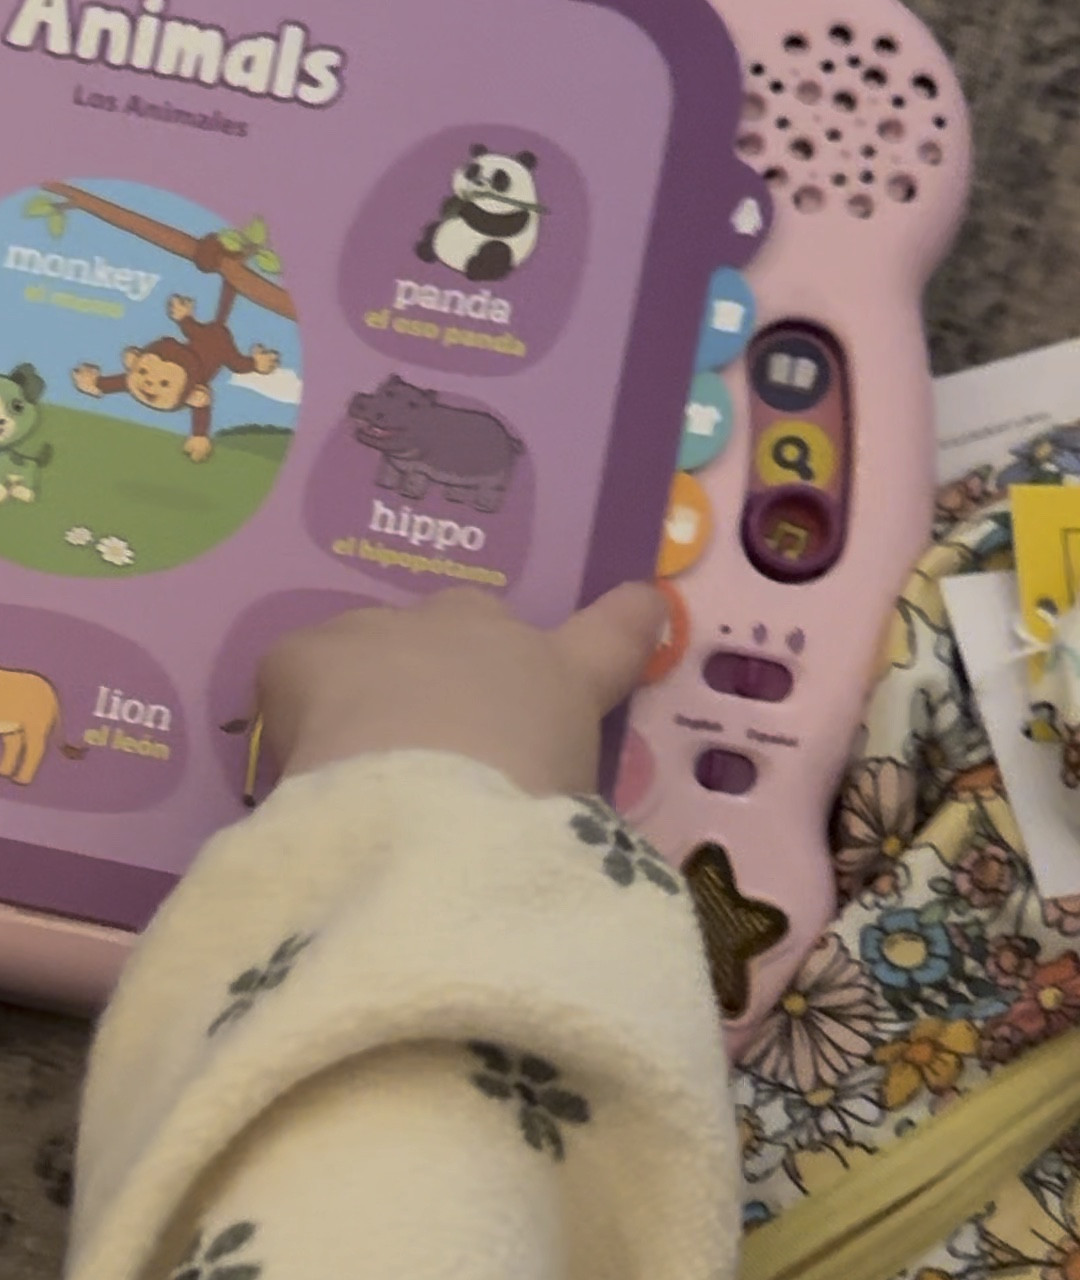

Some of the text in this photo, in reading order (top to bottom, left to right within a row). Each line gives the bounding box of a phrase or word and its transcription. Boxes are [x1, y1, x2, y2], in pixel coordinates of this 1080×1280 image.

[73, 84, 117, 112] Los
[3, 245, 160, 302] monkey
[393, 279, 512, 325] panda
[369, 499, 486, 551] hippo
[92, 685, 172, 732] lion
[83, 724, 110, 747] el
